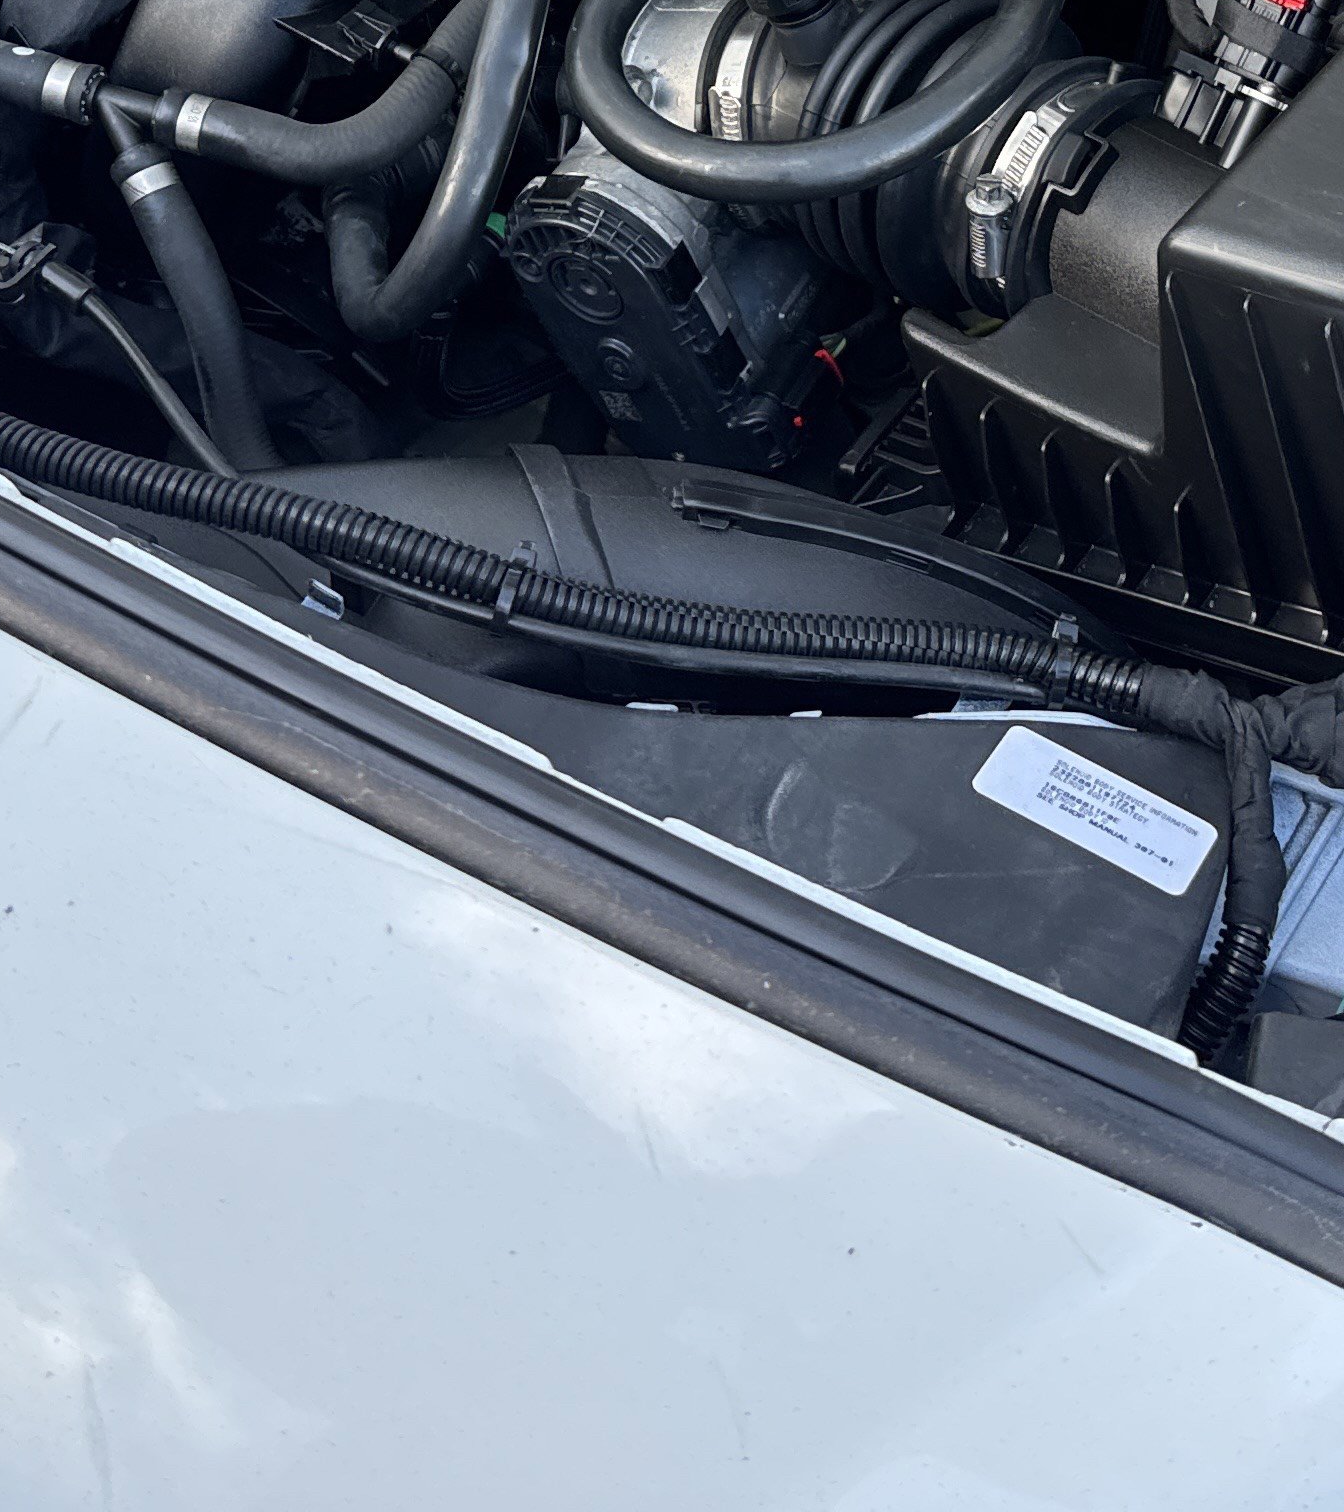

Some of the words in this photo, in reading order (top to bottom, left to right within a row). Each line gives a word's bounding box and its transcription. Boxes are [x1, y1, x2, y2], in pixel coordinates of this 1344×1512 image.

[1058, 802, 1085, 820] SHOP
[1087, 817, 1131, 844] MANUAL
[1093, 777, 1114, 792] BODY
[1115, 789, 1148, 810] SERVICE
[1148, 806, 1199, 836] INFORMATION
[1108, 799, 1149, 825] STRATEGY
